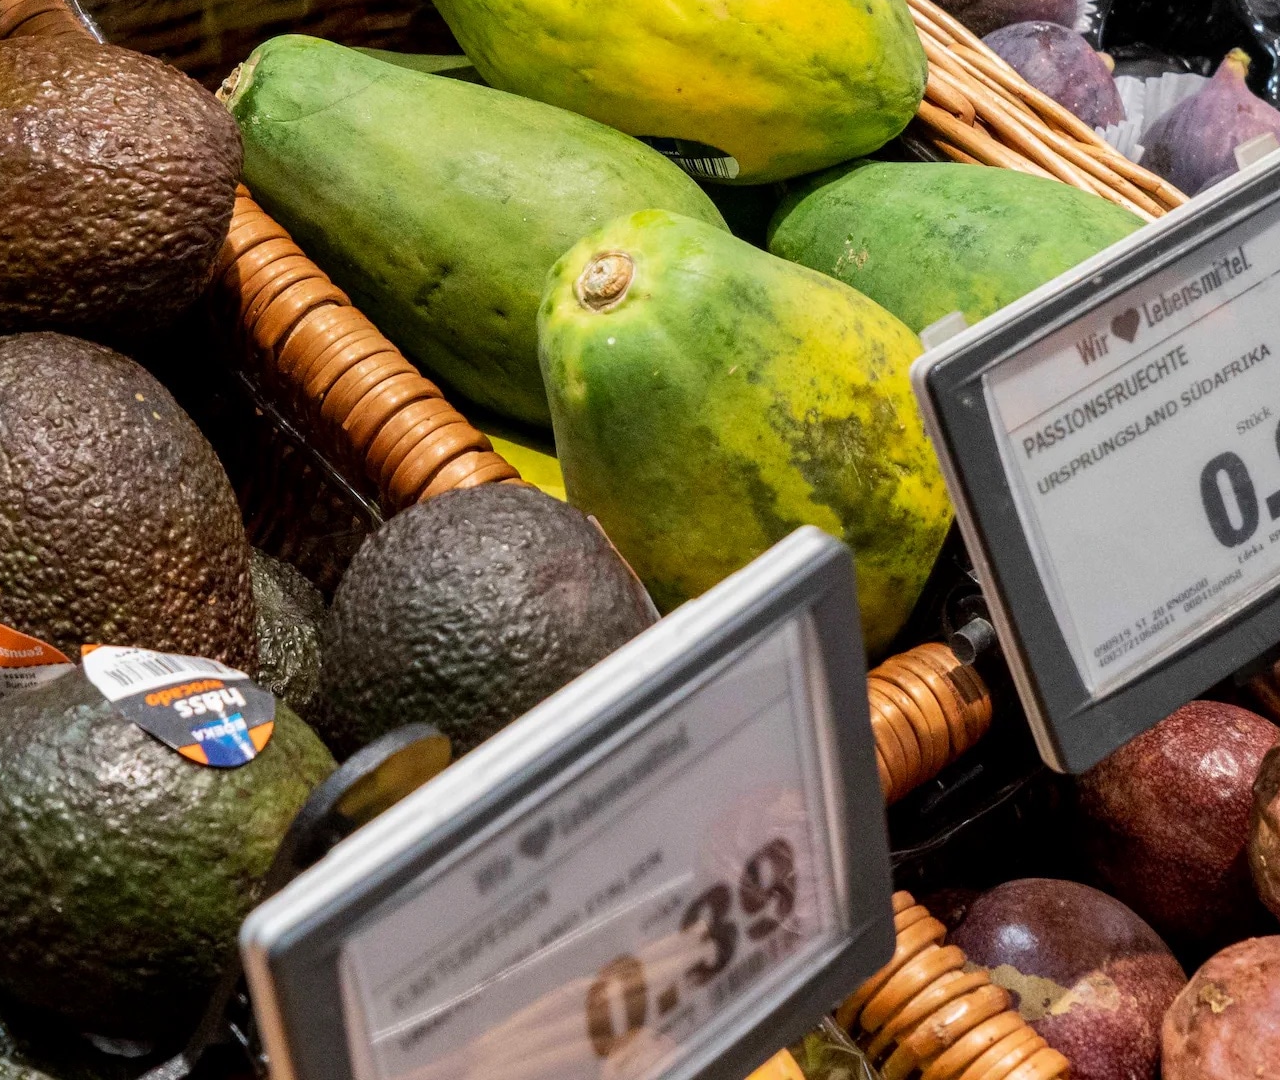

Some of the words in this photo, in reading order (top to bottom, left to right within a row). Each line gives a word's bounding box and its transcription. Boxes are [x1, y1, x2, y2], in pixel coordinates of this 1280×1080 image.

[1075, 330, 1111, 369] Wir
[1142, 246, 1254, 330] Lebensmittel.
[1022, 344, 1191, 459] PASSIONSFRUECHTE
[1036, 400, 1180, 497] URSPRUNGSLAND
[1180, 342, 1273, 410] SÜDAFRIKA
[1234, 404, 1274, 437] Stück
[144, 678, 225, 707] avocado
[173, 687, 247, 719] hass
[583, 835, 800, 1060] 0.39
